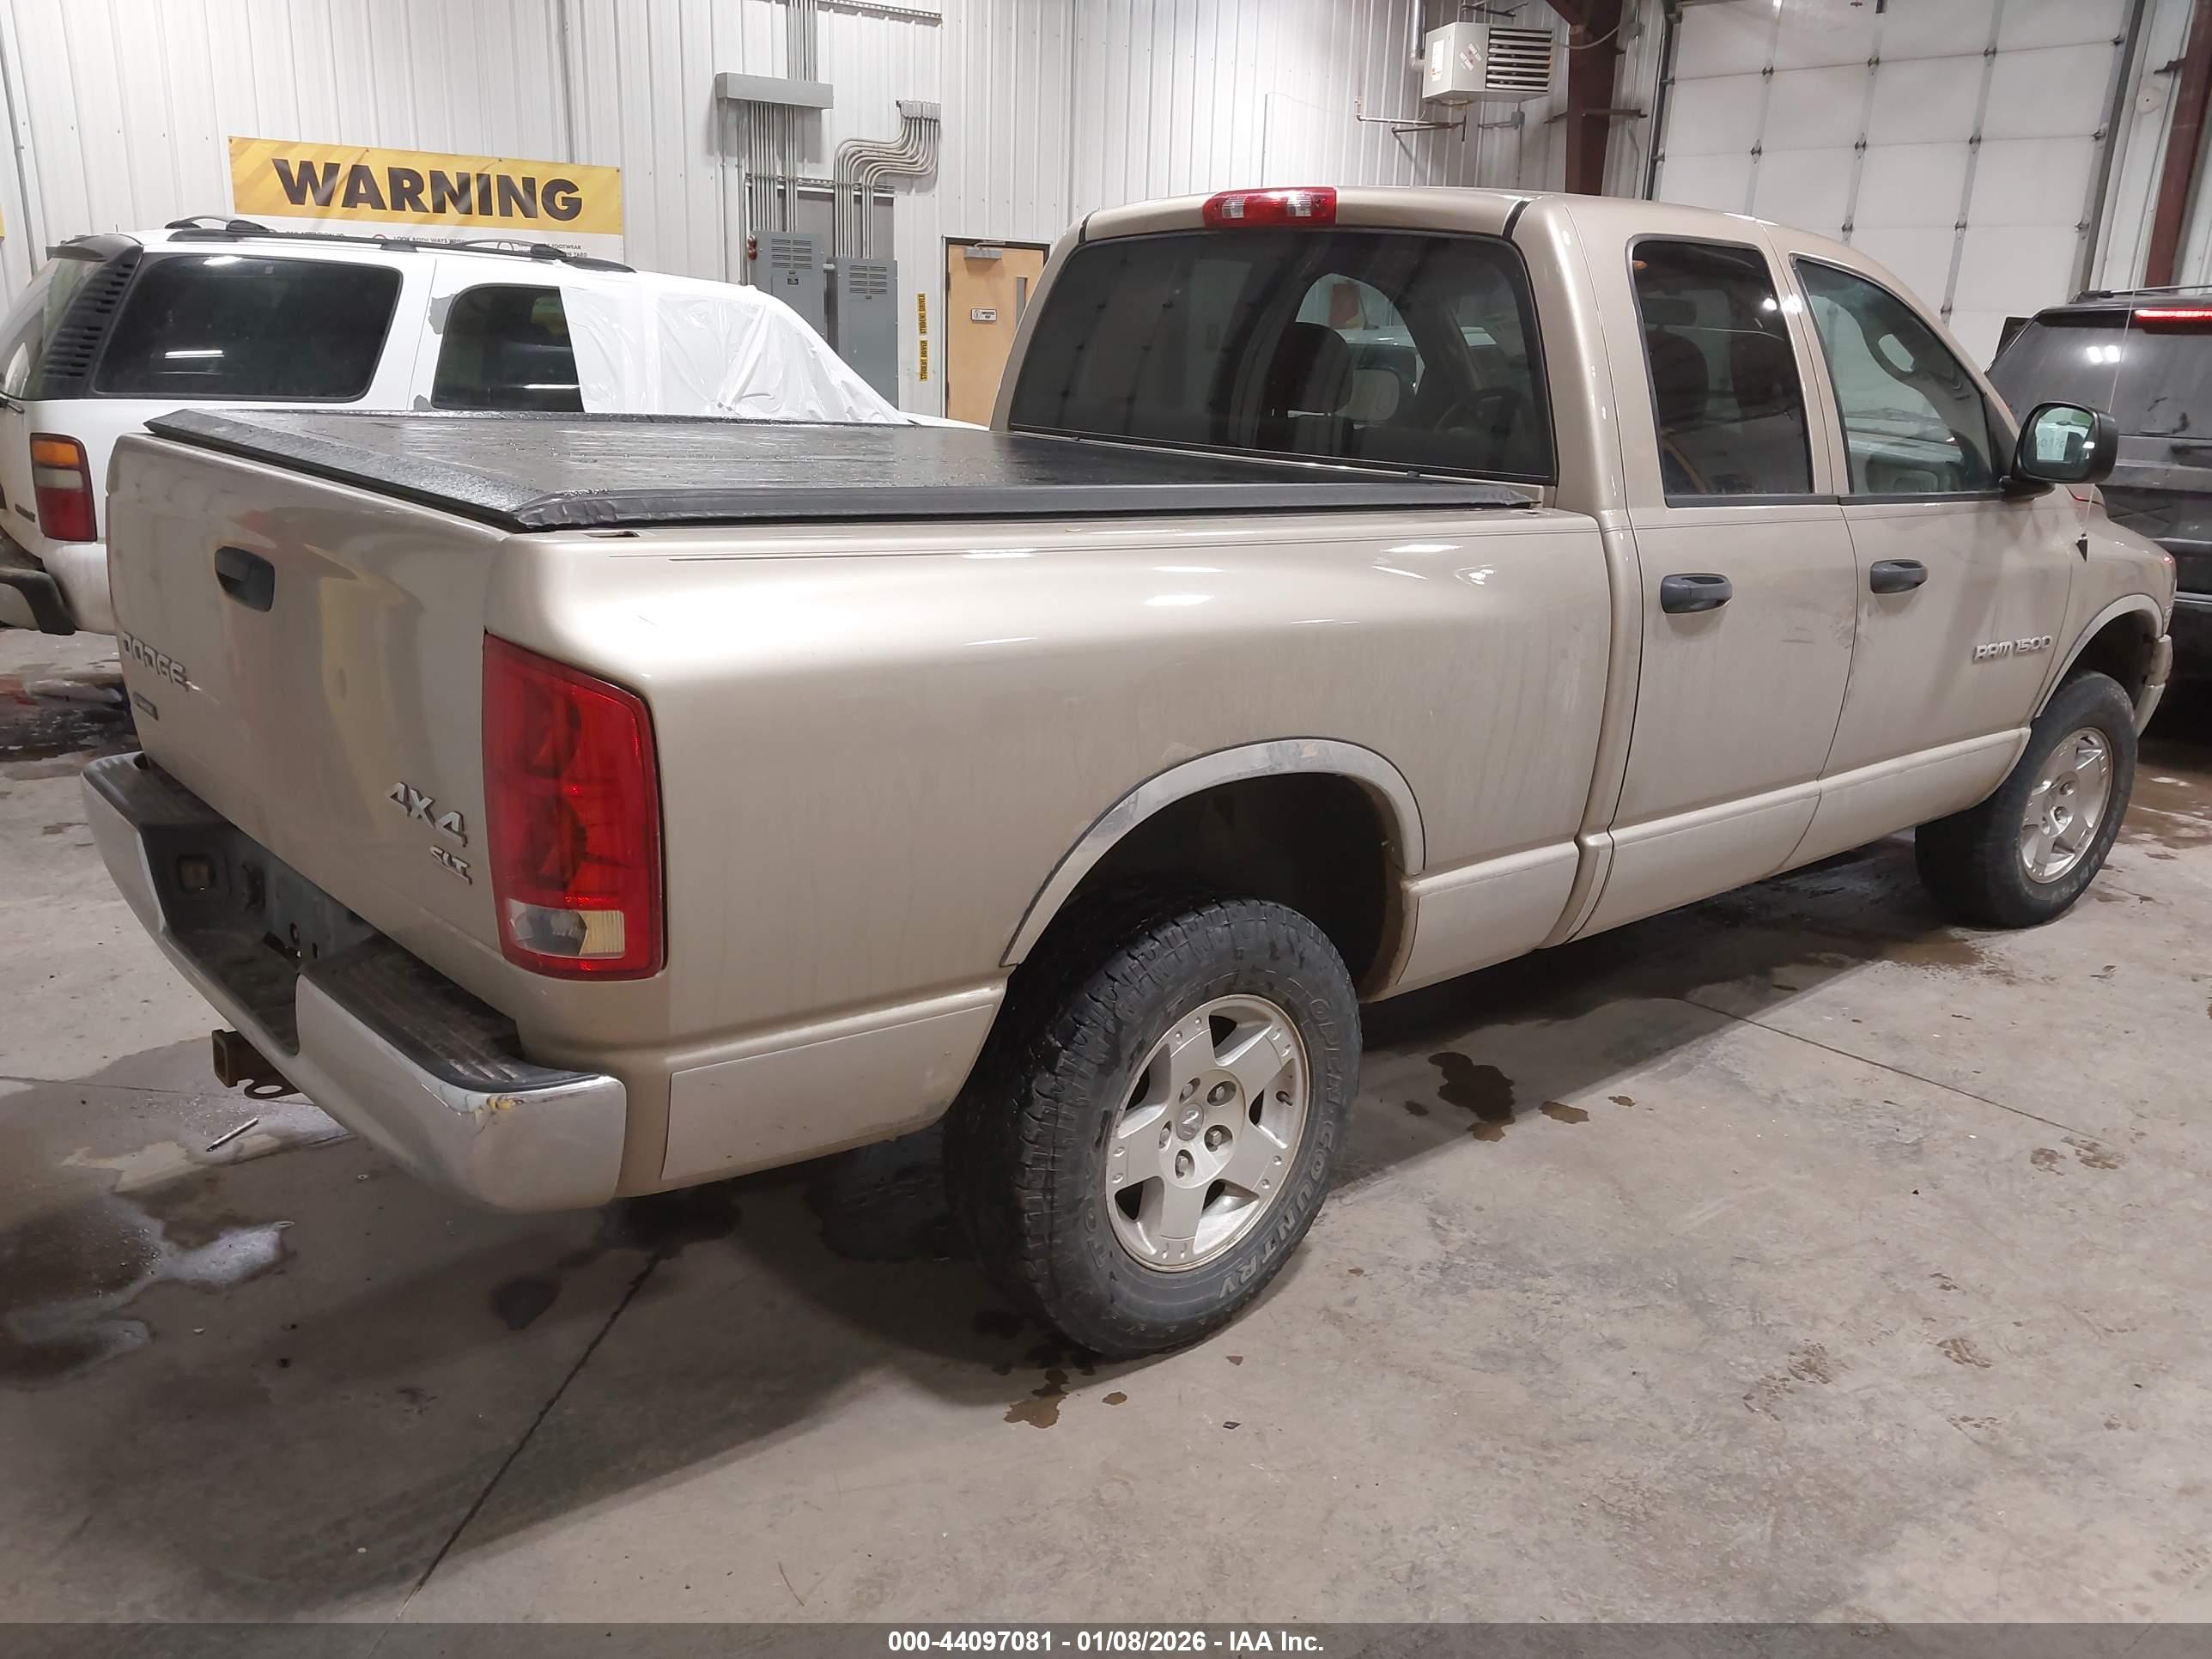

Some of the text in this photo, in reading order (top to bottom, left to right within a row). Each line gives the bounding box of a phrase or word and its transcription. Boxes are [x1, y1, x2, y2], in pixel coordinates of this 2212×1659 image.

[270, 158, 584, 222] WARNING
[122, 631, 189, 692] DODGE
[1972, 635, 2053, 661] RAM 1500
[429, 844, 473, 885] SLT
[1310, 998, 1342, 1106] OPEN
[1218, 1120, 1336, 1300] COUNTRY
